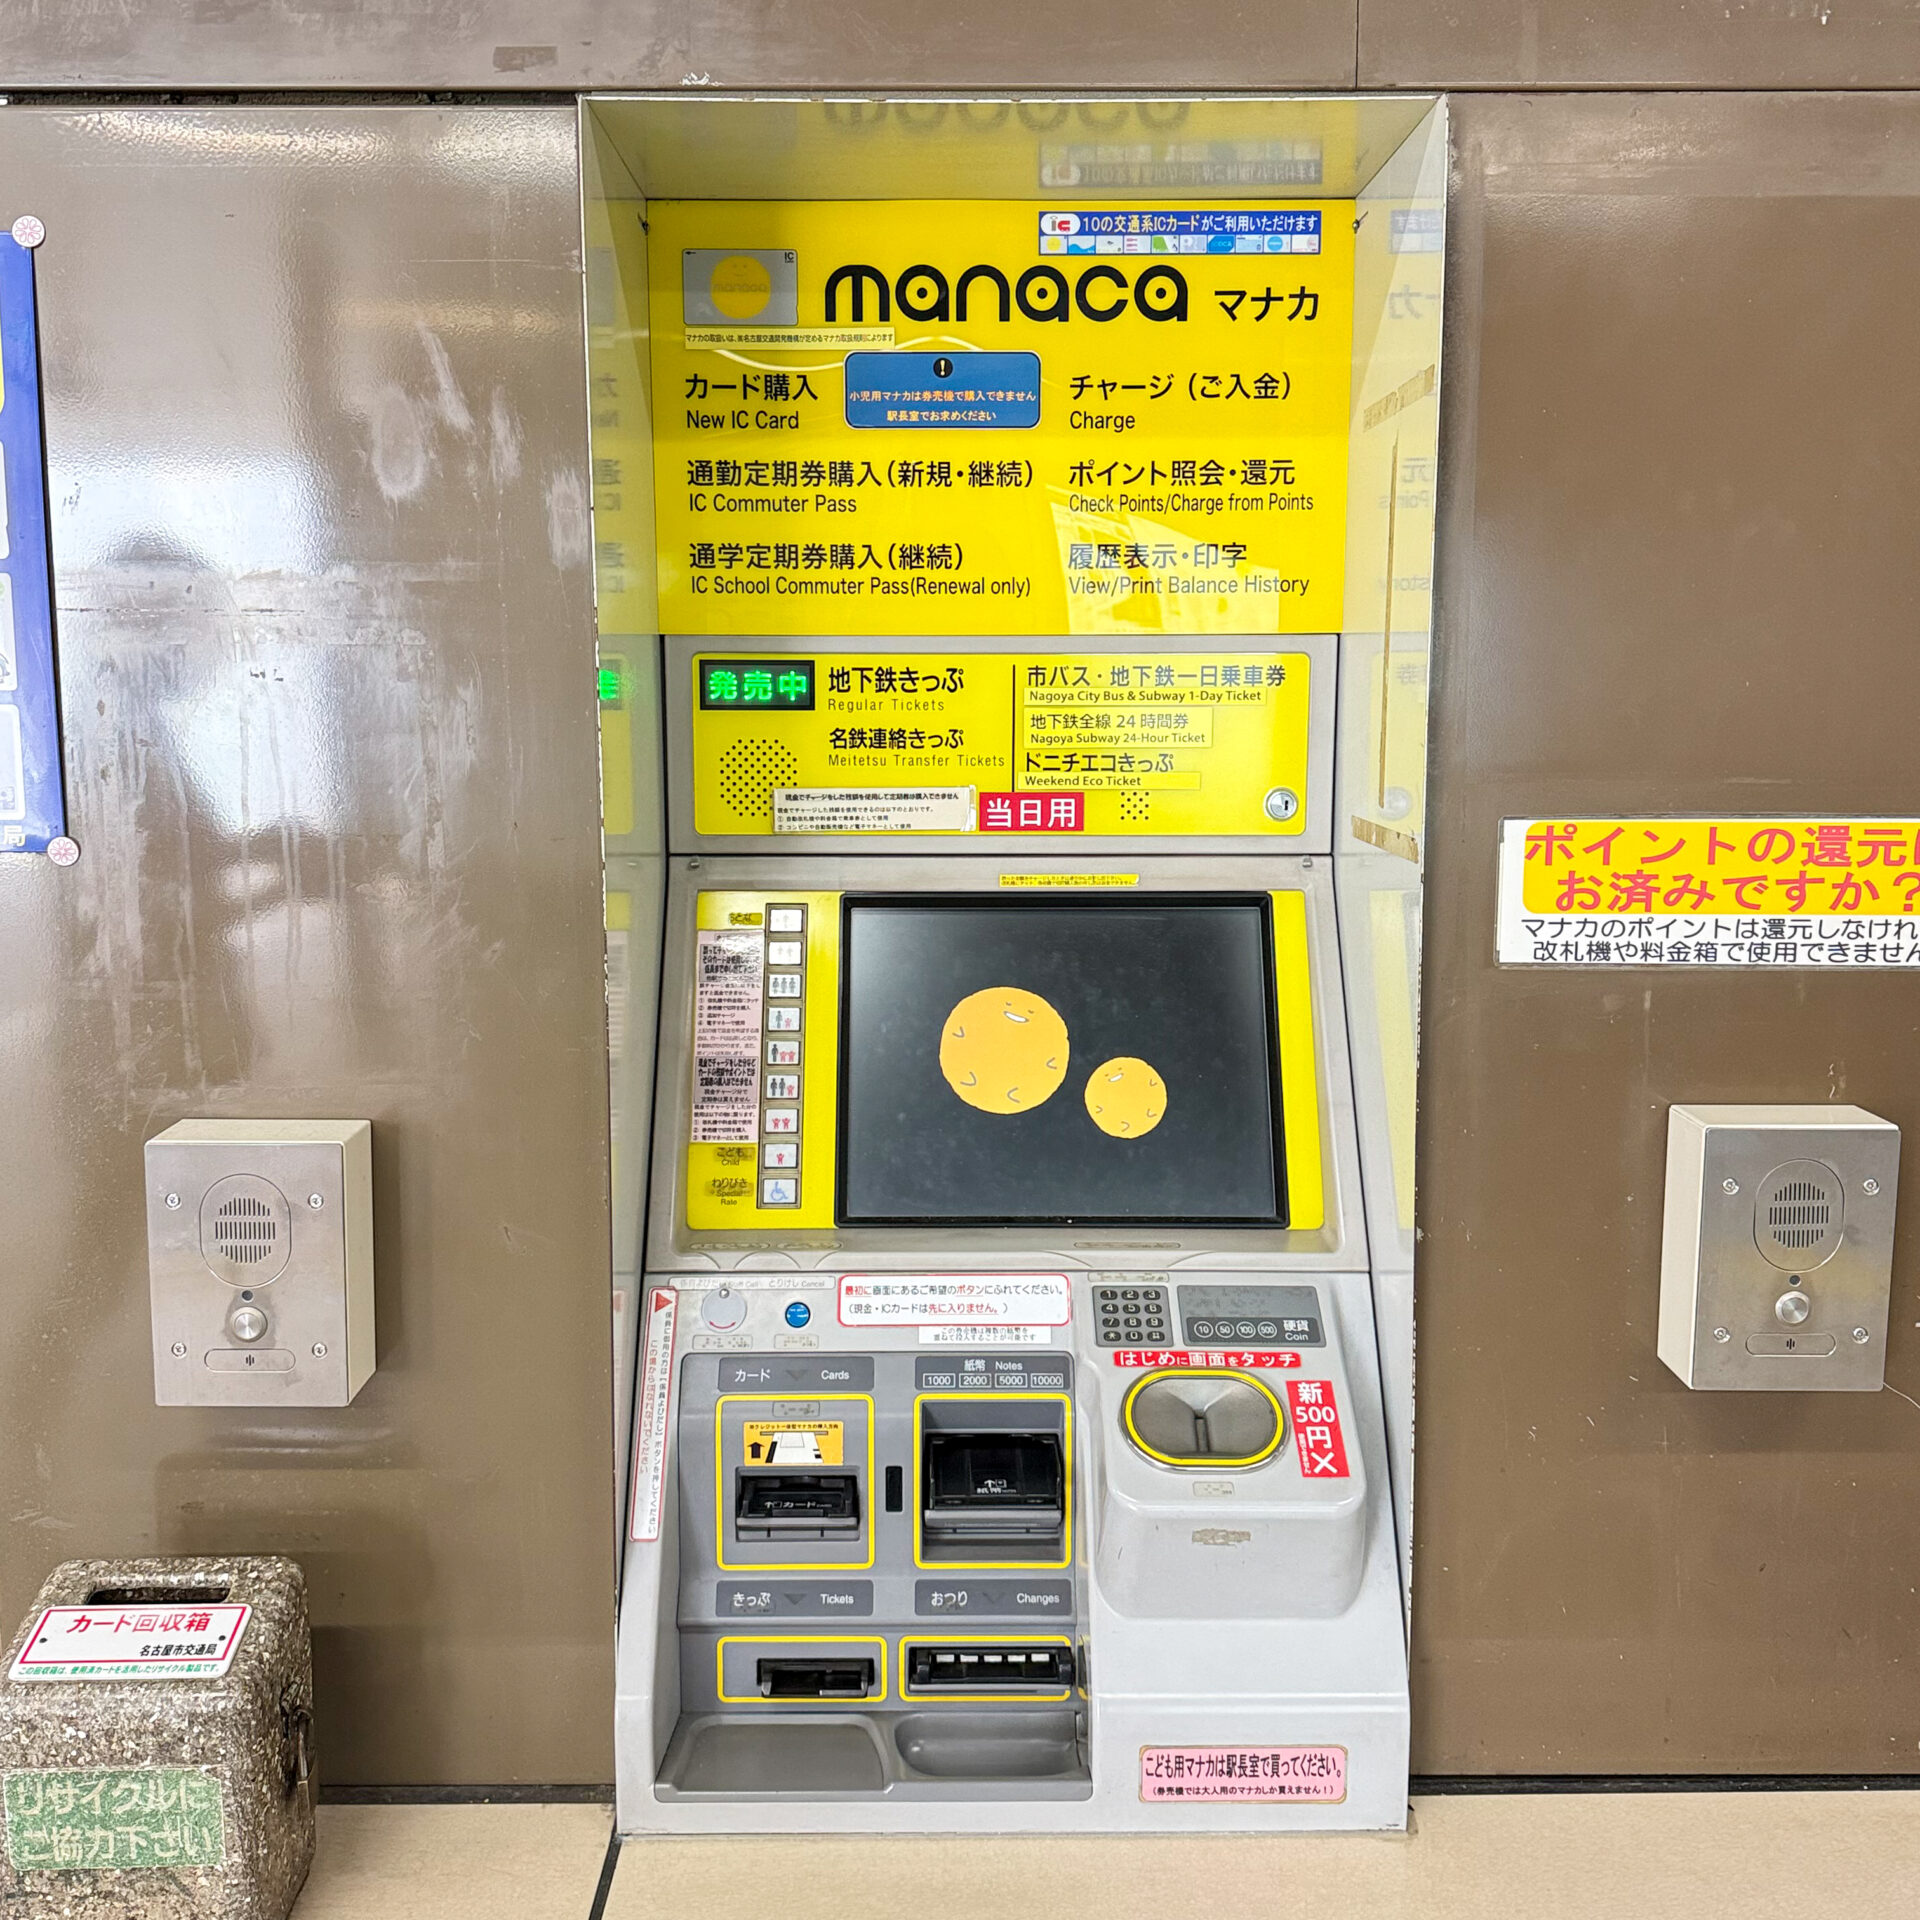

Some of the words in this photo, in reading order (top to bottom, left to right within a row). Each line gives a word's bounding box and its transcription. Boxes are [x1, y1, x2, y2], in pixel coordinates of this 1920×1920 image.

[1082, 214, 1318, 233] 10の交通系ICカードがご利用いただけます
[825, 264, 1188, 322] manaca
[1214, 285, 1319, 322] マナカ
[685, 373, 818, 401] カード購入
[850, 390, 1036, 402] 小児用マナカは券売機で購入できません
[686, 411, 725, 429] New
[732, 411, 749, 429] IC
[755, 411, 799, 429] Card
[886, 410, 996, 422] 駅長室でお求めください
[1069, 411, 1135, 432] Charge
[686, 460, 1033, 488] 通勤定期券購入（新規・継続）
[1068, 459, 1296, 487] ポイント照会・還元
[689, 494, 707, 512] IC
[713, 494, 808, 512] Commuter
[815, 494, 857, 512] Pass
[1069, 494, 1114, 512] Check
[1119, 494, 1223, 515] Points/Charge
[1229, 493, 1263, 511] from
[1269, 493, 1313, 511] Points
[689, 543, 964, 570] 通学定期券購入（継続）
[1068, 542, 1247, 570] 履歴表示・印字
[692, 576, 708, 594] IC
[713, 576, 769, 594] School
[775, 577, 864, 594] Commuter
[871, 576, 984, 597] Pass(Renewal
[991, 577, 1031, 598] only)
[1069, 576, 1162, 597] View/Print
[1168, 576, 1238, 594] Balance
[1245, 576, 1309, 596] History
[828, 666, 965, 694] 地下鉄きっぷ
[1027, 665, 1286, 688] 市バス・地下鉄一日乗車券
[708, 670, 808, 702] 発売中
[828, 698, 883, 713] Regular
[892, 698, 945, 711] Tickets
[1029, 691, 1074, 704] Nagoya
[1077, 690, 1100, 704] City
[1103, 690, 1124, 702] Bus
[1127, 690, 1136, 702] &
[1139, 690, 1187, 704] Subway
[1189, 690, 1223, 704] 1-Day
[1225, 690, 1261, 701] Ticket
[1030, 713, 1111, 730] 地下鉄全線
[1117, 714, 1136, 729] 24
[1140, 713, 1189, 729] 時間券
[829, 728, 965, 750] 名鉄連絡きっぷ
[1030, 733, 1073, 746] Nagoya
[1076, 732, 1120, 746] Subway
[1123, 732, 1169, 744] 24-Hour
[1173, 732, 1205, 743] Ticket
[828, 754, 887, 767] Meitetsu
[894, 754, 949, 767] Transfer
[957, 754, 1005, 767] Tickets
[1026, 752, 1174, 773] ドニチエコきっぷ
[1025, 775, 1080, 786] Weekend
[1083, 776, 1103, 786] Eco
[1106, 776, 1141, 786] Ticket
[986, 797, 1076, 828] 当日用
[1525, 823, 1920, 868] ポイントの還元
[1521, 917, 1918, 941] マナカのポイントは還元しなけれ
[845, 1284, 1063, 1297] 最初に画面にあるご希望のボタンにふれてください。
[1199, 1325, 1209, 1334] 10
[1219, 1325, 1231, 1334] 50
[1240, 1325, 1253, 1334] 100
[1260, 1326, 1275, 1334] 500
[1284, 1332, 1309, 1341] Coin
[964, 1359, 986, 1371] 紙幣
[995, 1361, 1023, 1371] Notes
[1119, 1351, 1296, 1367] はじめに画面をタッチ
[734, 1368, 771, 1383] カード
[821, 1370, 850, 1380] Cards
[927, 1376, 951, 1386] 1000
[963, 1376, 988, 1386] 2000
[999, 1376, 1024, 1386] 5000
[1032, 1376, 1063, 1386] 10000
[732, 1592, 771, 1608] きっぷ
[820, 1593, 854, 1604] Tickets
[931, 1591, 968, 1607] おつり
[1016, 1593, 1060, 1606] Changes
[66, 1612, 213, 1634] カード回収箱
[139, 1643, 218, 1658] 名古屋市交通局
[1146, 1753, 1341, 1779] こども用マナカは駅長室で買ってください。
[17, 1779, 211, 1816] リサイクルに
[22, 1825, 212, 1862] ご協力下さい
